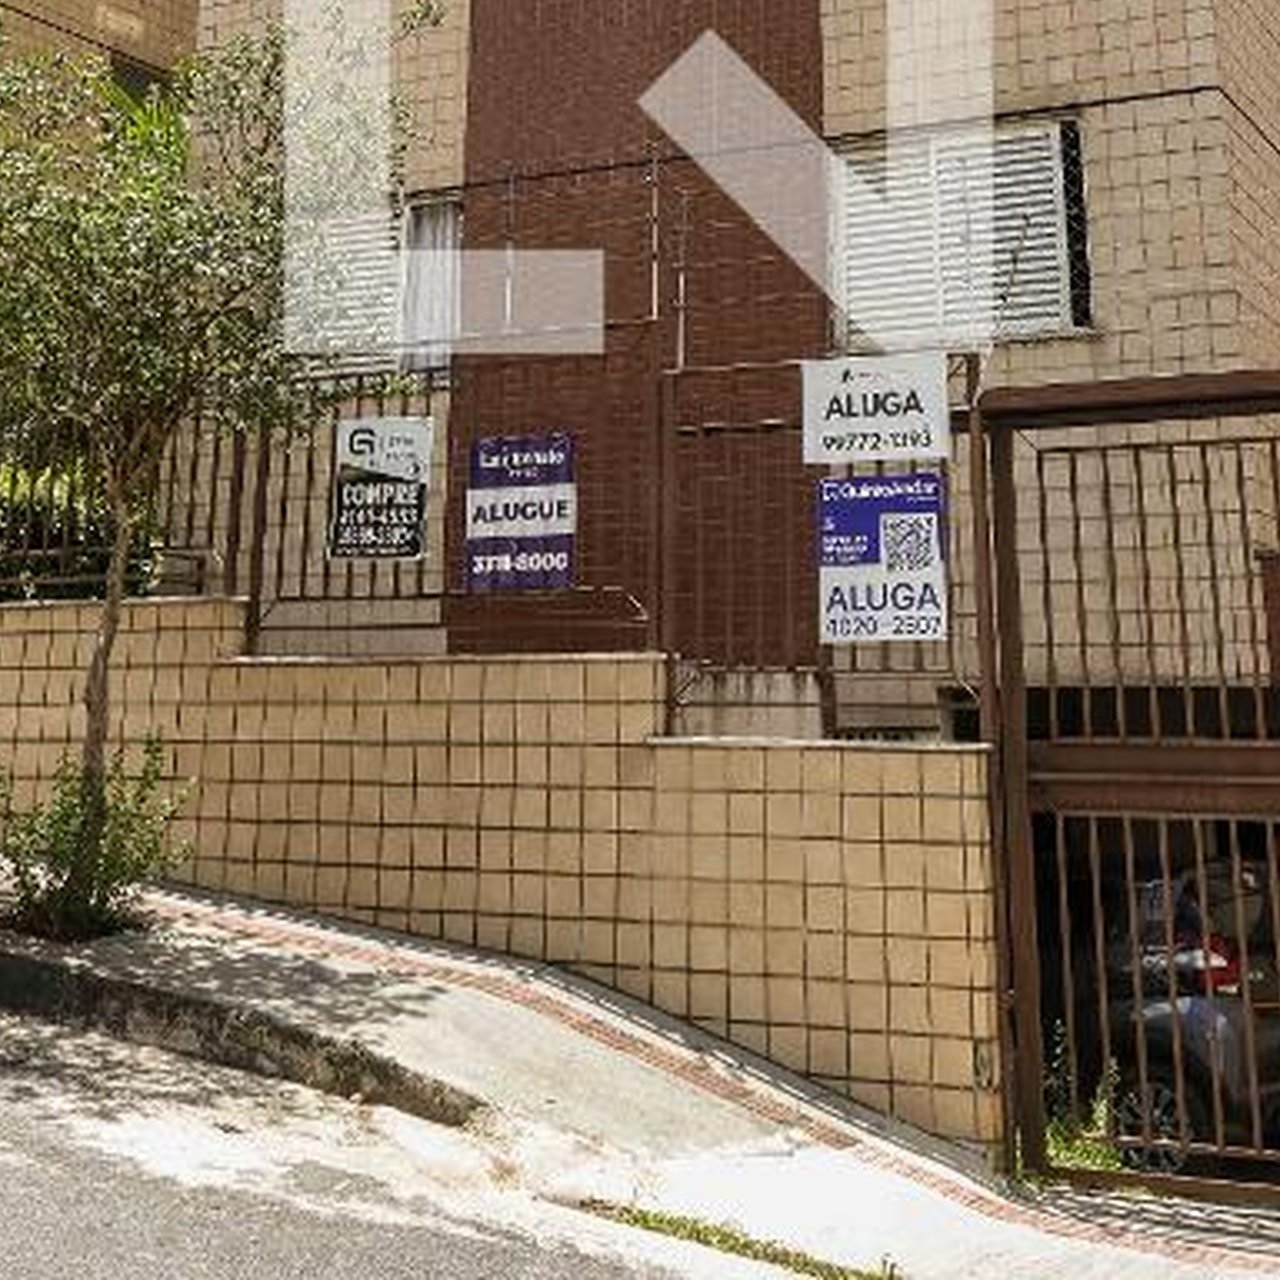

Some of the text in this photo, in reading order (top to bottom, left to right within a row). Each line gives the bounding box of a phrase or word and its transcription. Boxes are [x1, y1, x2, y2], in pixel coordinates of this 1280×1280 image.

[825, 389, 924, 420] ALUGA
[342, 482, 419, 505] COMPRE
[473, 500, 569, 524] ALUGUE
[827, 583, 942, 614] ALUGA
